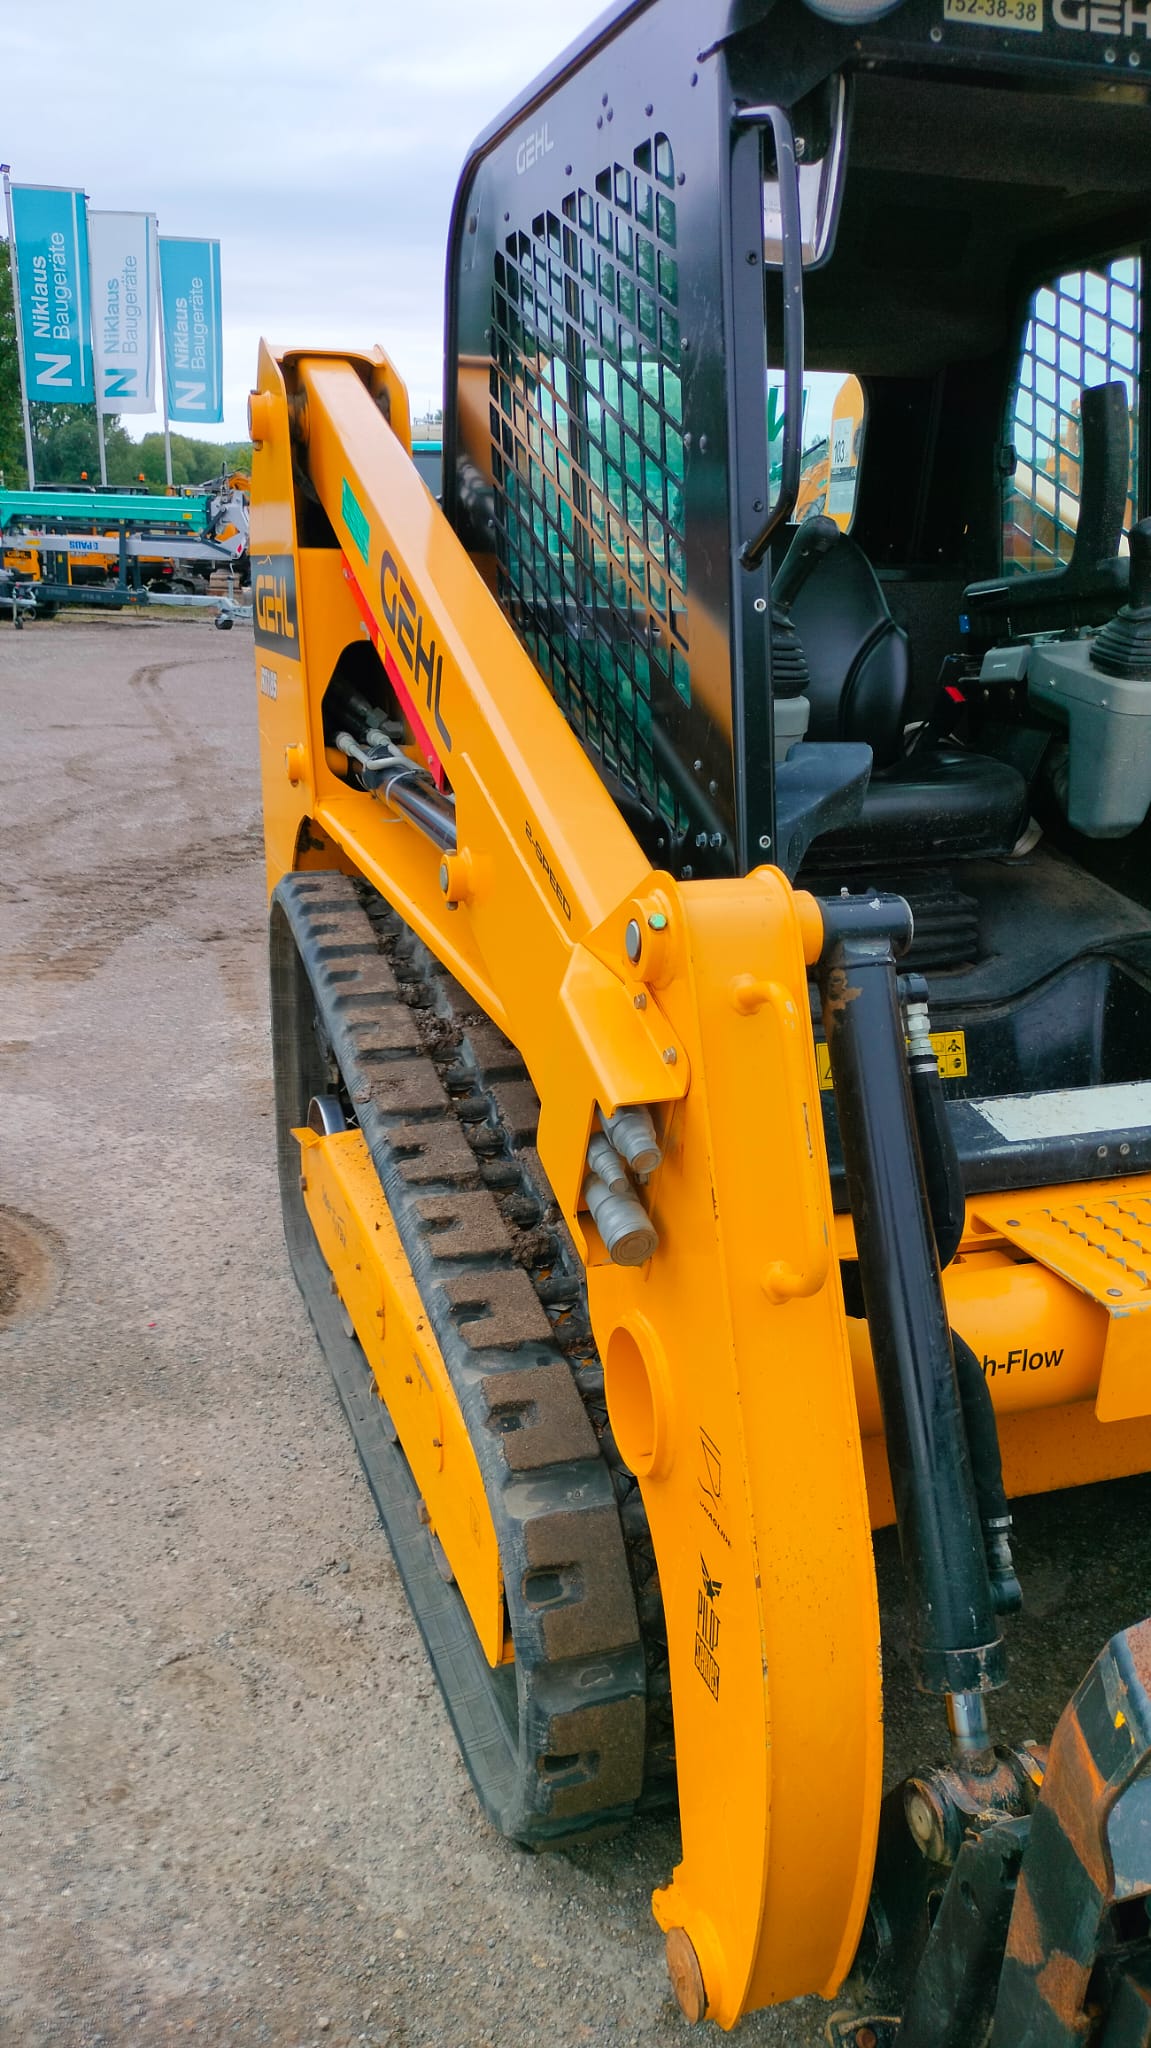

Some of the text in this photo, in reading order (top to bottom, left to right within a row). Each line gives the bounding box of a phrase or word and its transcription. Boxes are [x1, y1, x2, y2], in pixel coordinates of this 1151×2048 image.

[516, 121, 554, 175] GEHL
[32, 255, 50, 338] Niklaus
[49, 231, 72, 341] Baugeräte
[103, 277, 120, 354] Niklaus
[122, 254, 142, 355] Baugeräte
[174, 296, 189, 368] Niklaus
[189, 276, 209, 370] Baugeräte
[36, 353, 73, 387] N
[104, 368, 138, 398] N
[175, 380, 208, 411] N
[834, 439, 846, 464] 103
[256, 574, 295, 639] GEHL
[380, 549, 453, 753] GEHL
[525, 819, 572, 922] 2-SPEED
[981, 1348, 1065, 1377] h-Flow
[697, 1588, 721, 1652] PILOT
